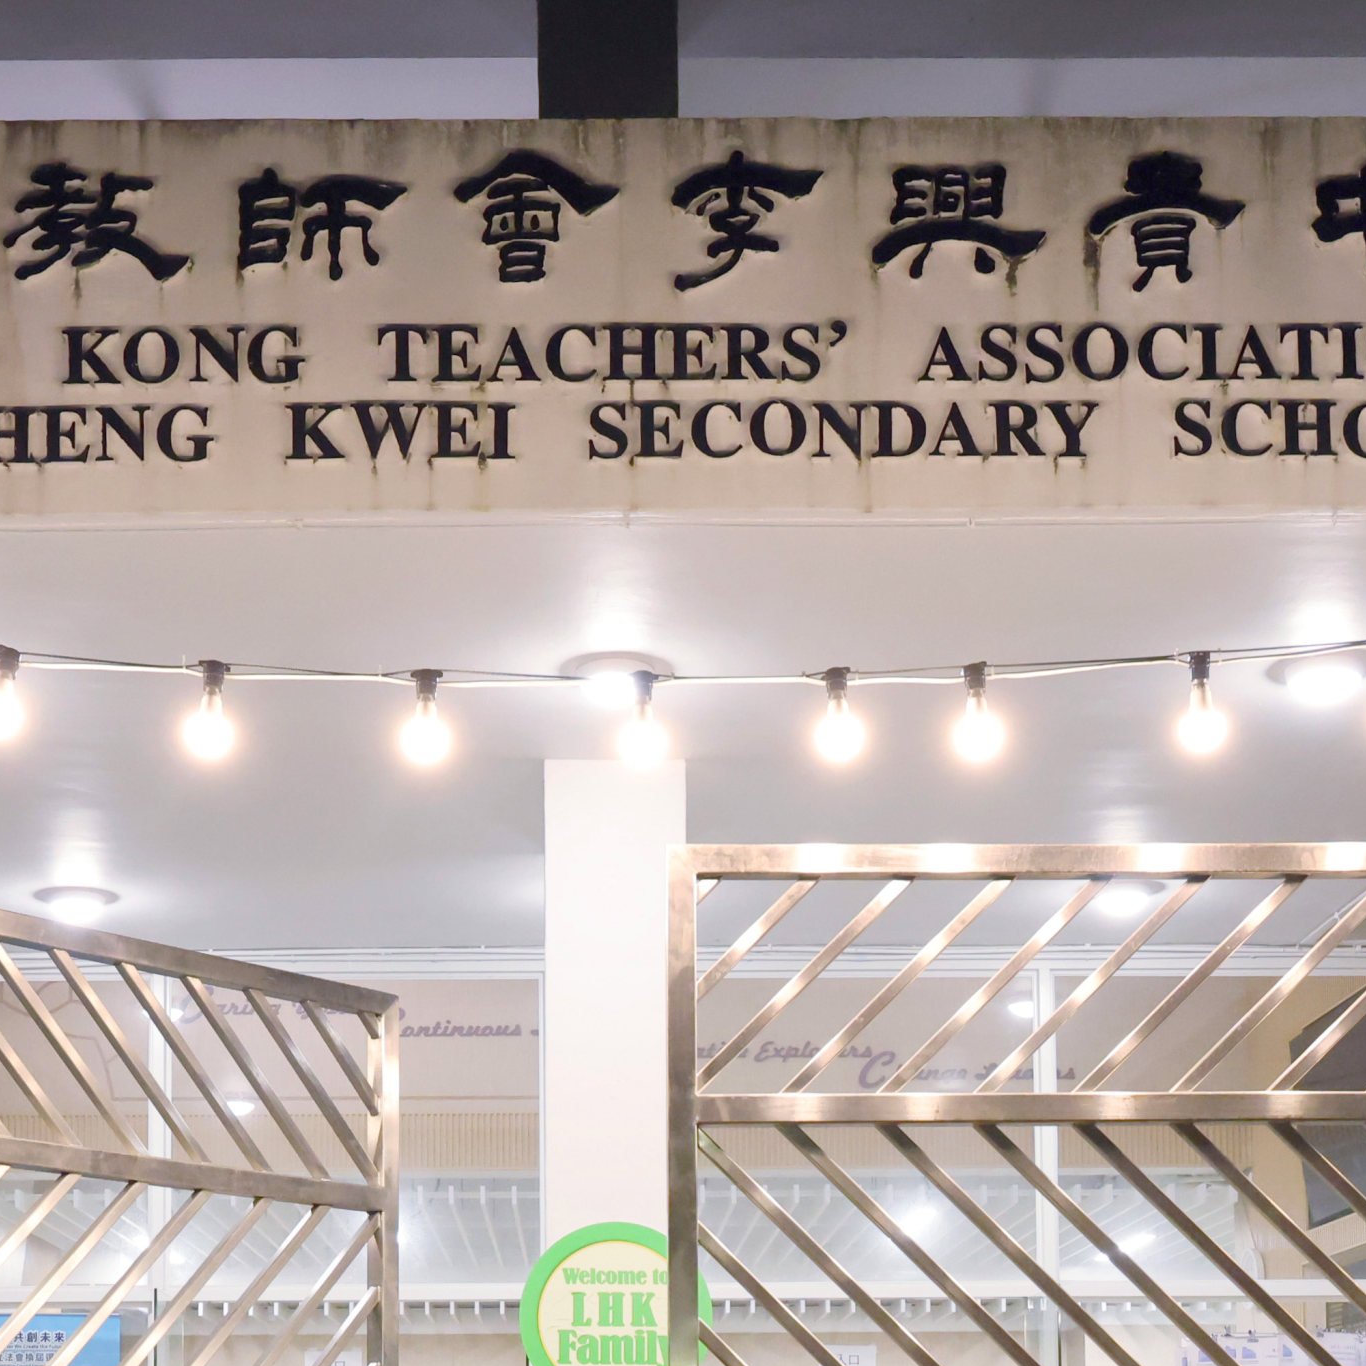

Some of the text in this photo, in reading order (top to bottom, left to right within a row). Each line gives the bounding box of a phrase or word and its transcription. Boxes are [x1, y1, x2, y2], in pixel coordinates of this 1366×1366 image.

[62, 325, 304, 388] KONG
[286, 401, 515, 461] KWEI
[589, 400, 1098, 460] SECONDARY
[396, 1012, 522, 1037] ontinuous
[562, 1268, 668, 1285] Welcome to
